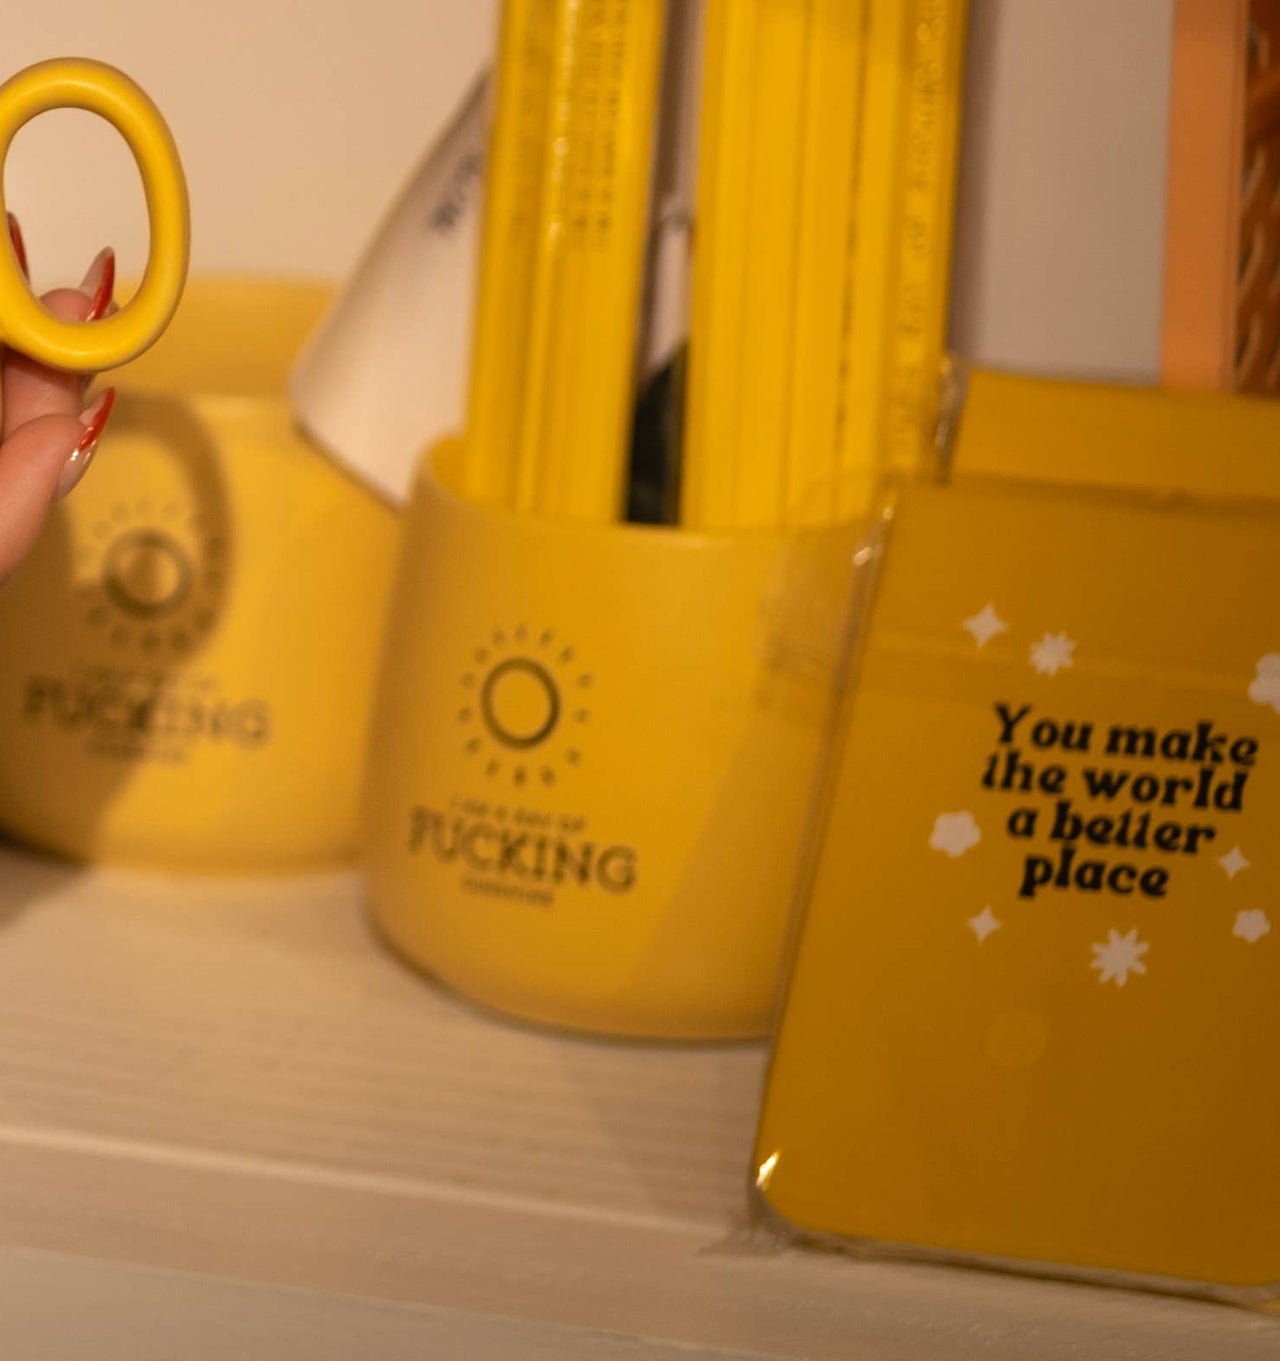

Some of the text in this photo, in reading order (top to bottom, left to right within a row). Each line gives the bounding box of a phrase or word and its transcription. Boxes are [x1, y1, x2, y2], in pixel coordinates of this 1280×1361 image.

[994, 701, 1259, 767] You make
[981, 747, 1248, 812] the world
[408, 802, 637, 896] FUCKING
[1007, 800, 1216, 855] a better
[1017, 845, 1169, 900] place
